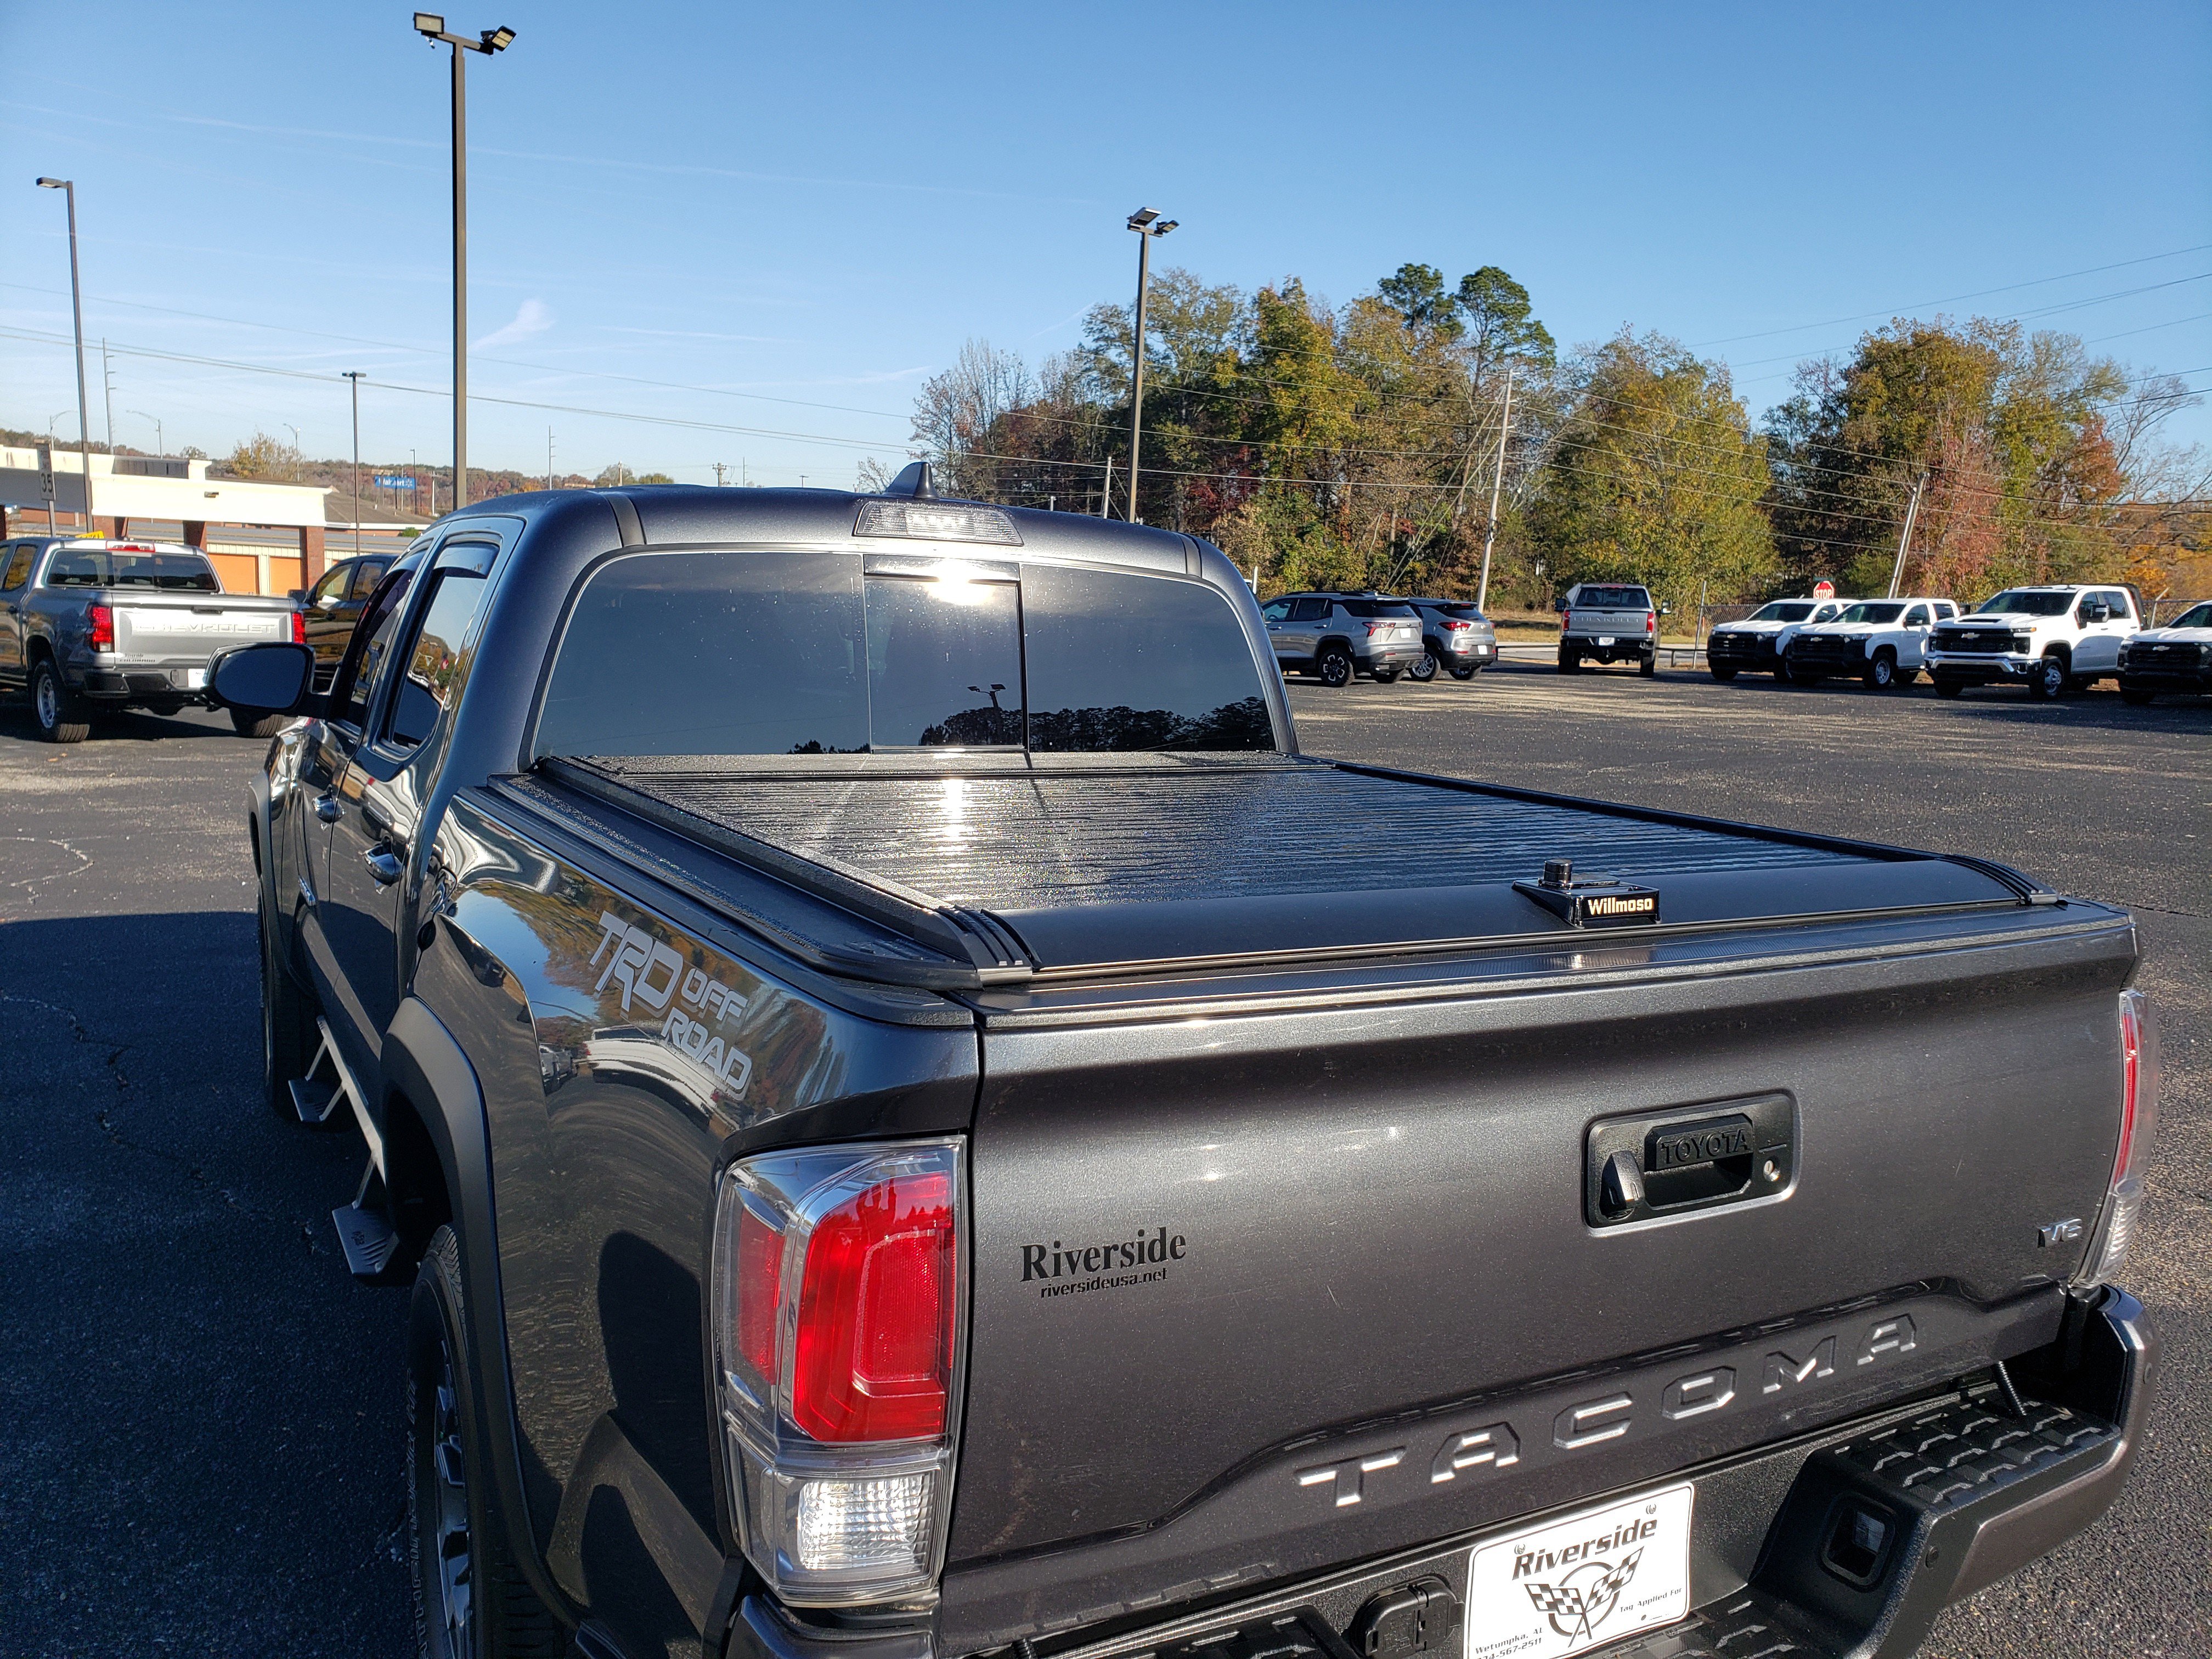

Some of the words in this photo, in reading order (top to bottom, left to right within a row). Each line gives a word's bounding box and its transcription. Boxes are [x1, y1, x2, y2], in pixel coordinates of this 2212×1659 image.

[41, 473, 53, 493] 35
[1815, 589, 1832, 600] STOP
[133, 623, 276, 634] CHEVROLET
[1588, 897, 1654, 916] Willmoso
[589, 910, 684, 1013] TRD
[681, 968, 749, 1021] OFF
[661, 1006, 752, 1091] ROAD
[1661, 1128, 1750, 1165] TOYOTA
[1020, 1226, 1186, 1283] Riverside
[1040, 1267, 1168, 1299] riversideusa.net
[1294, 1313, 1918, 1507] TACOMA
[1511, 1518, 1657, 1581] Riverside
[1620, 1604, 1634, 1612] Tag
[1638, 1592, 1667, 1607] Applied
[1670, 1588, 1682, 1596] For
